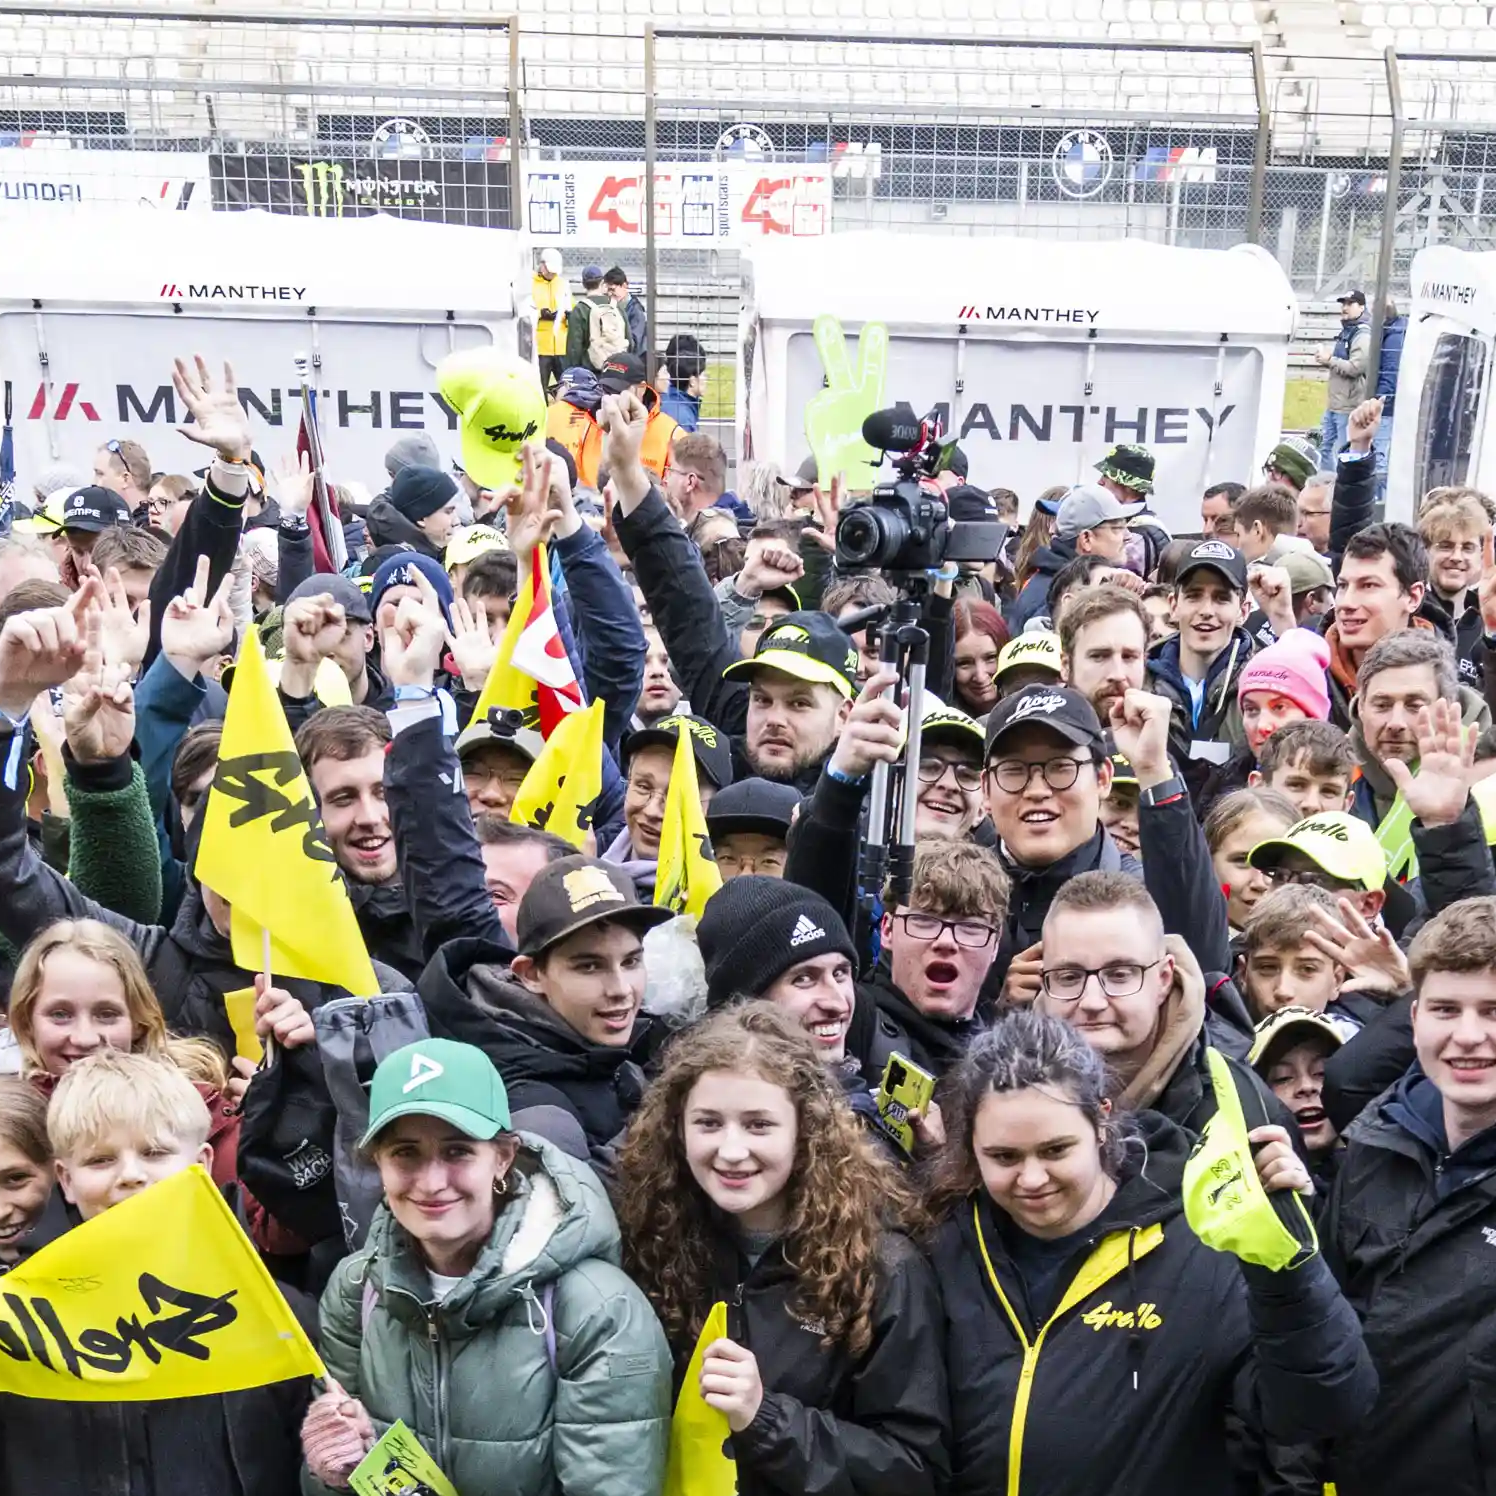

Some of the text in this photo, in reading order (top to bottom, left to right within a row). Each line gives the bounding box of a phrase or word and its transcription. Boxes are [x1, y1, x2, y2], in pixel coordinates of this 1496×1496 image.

[188, 284, 306, 300] MANTHEY
[1430, 283, 1477, 305] MANTHEY
[985, 306, 1100, 323] MANTHEY
[1007, 639, 1054, 660] Grello
[790, 926, 826, 947] adidas
